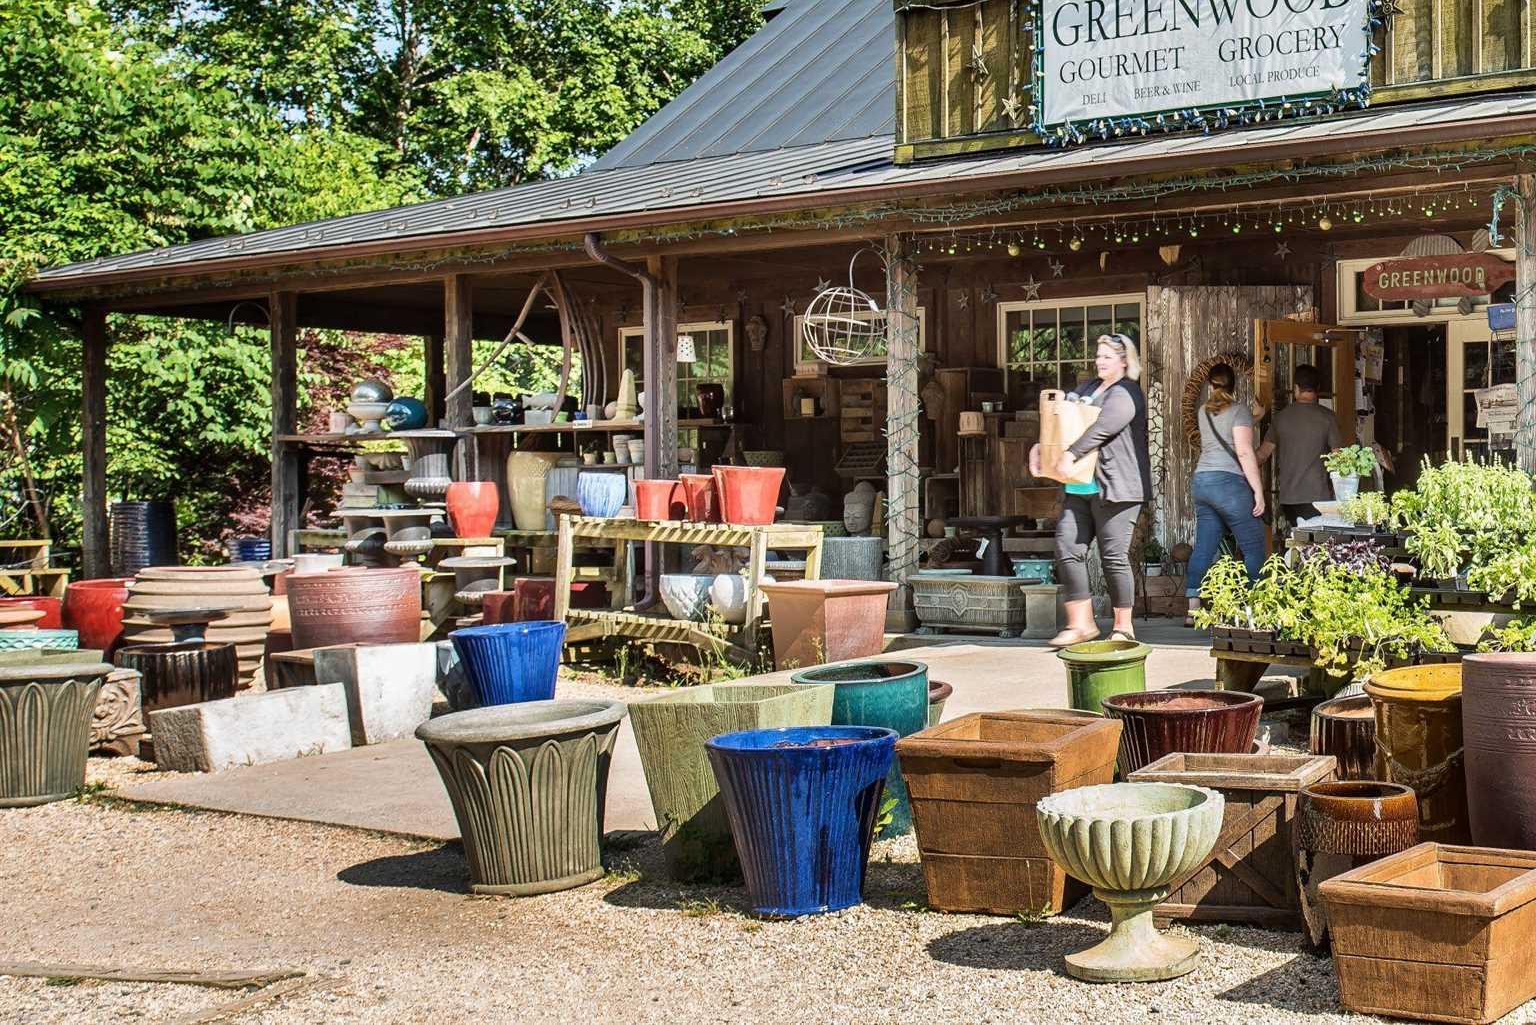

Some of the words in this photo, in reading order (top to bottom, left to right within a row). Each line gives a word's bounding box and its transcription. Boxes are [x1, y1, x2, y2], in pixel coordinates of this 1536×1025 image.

[1059, 46, 1185, 84] GOURMET
[1218, 23, 1346, 63] GROCERY
[1082, 92, 1107, 106] DELI
[1134, 85, 1161, 100] BEER
[1162, 85, 1171, 96] &
[1173, 80, 1201, 94] WINE
[1229, 72, 1265, 88] LOCAL
[1267, 65, 1320, 84] PRODUCE
[1378, 266, 1485, 289] GREENWOOD
